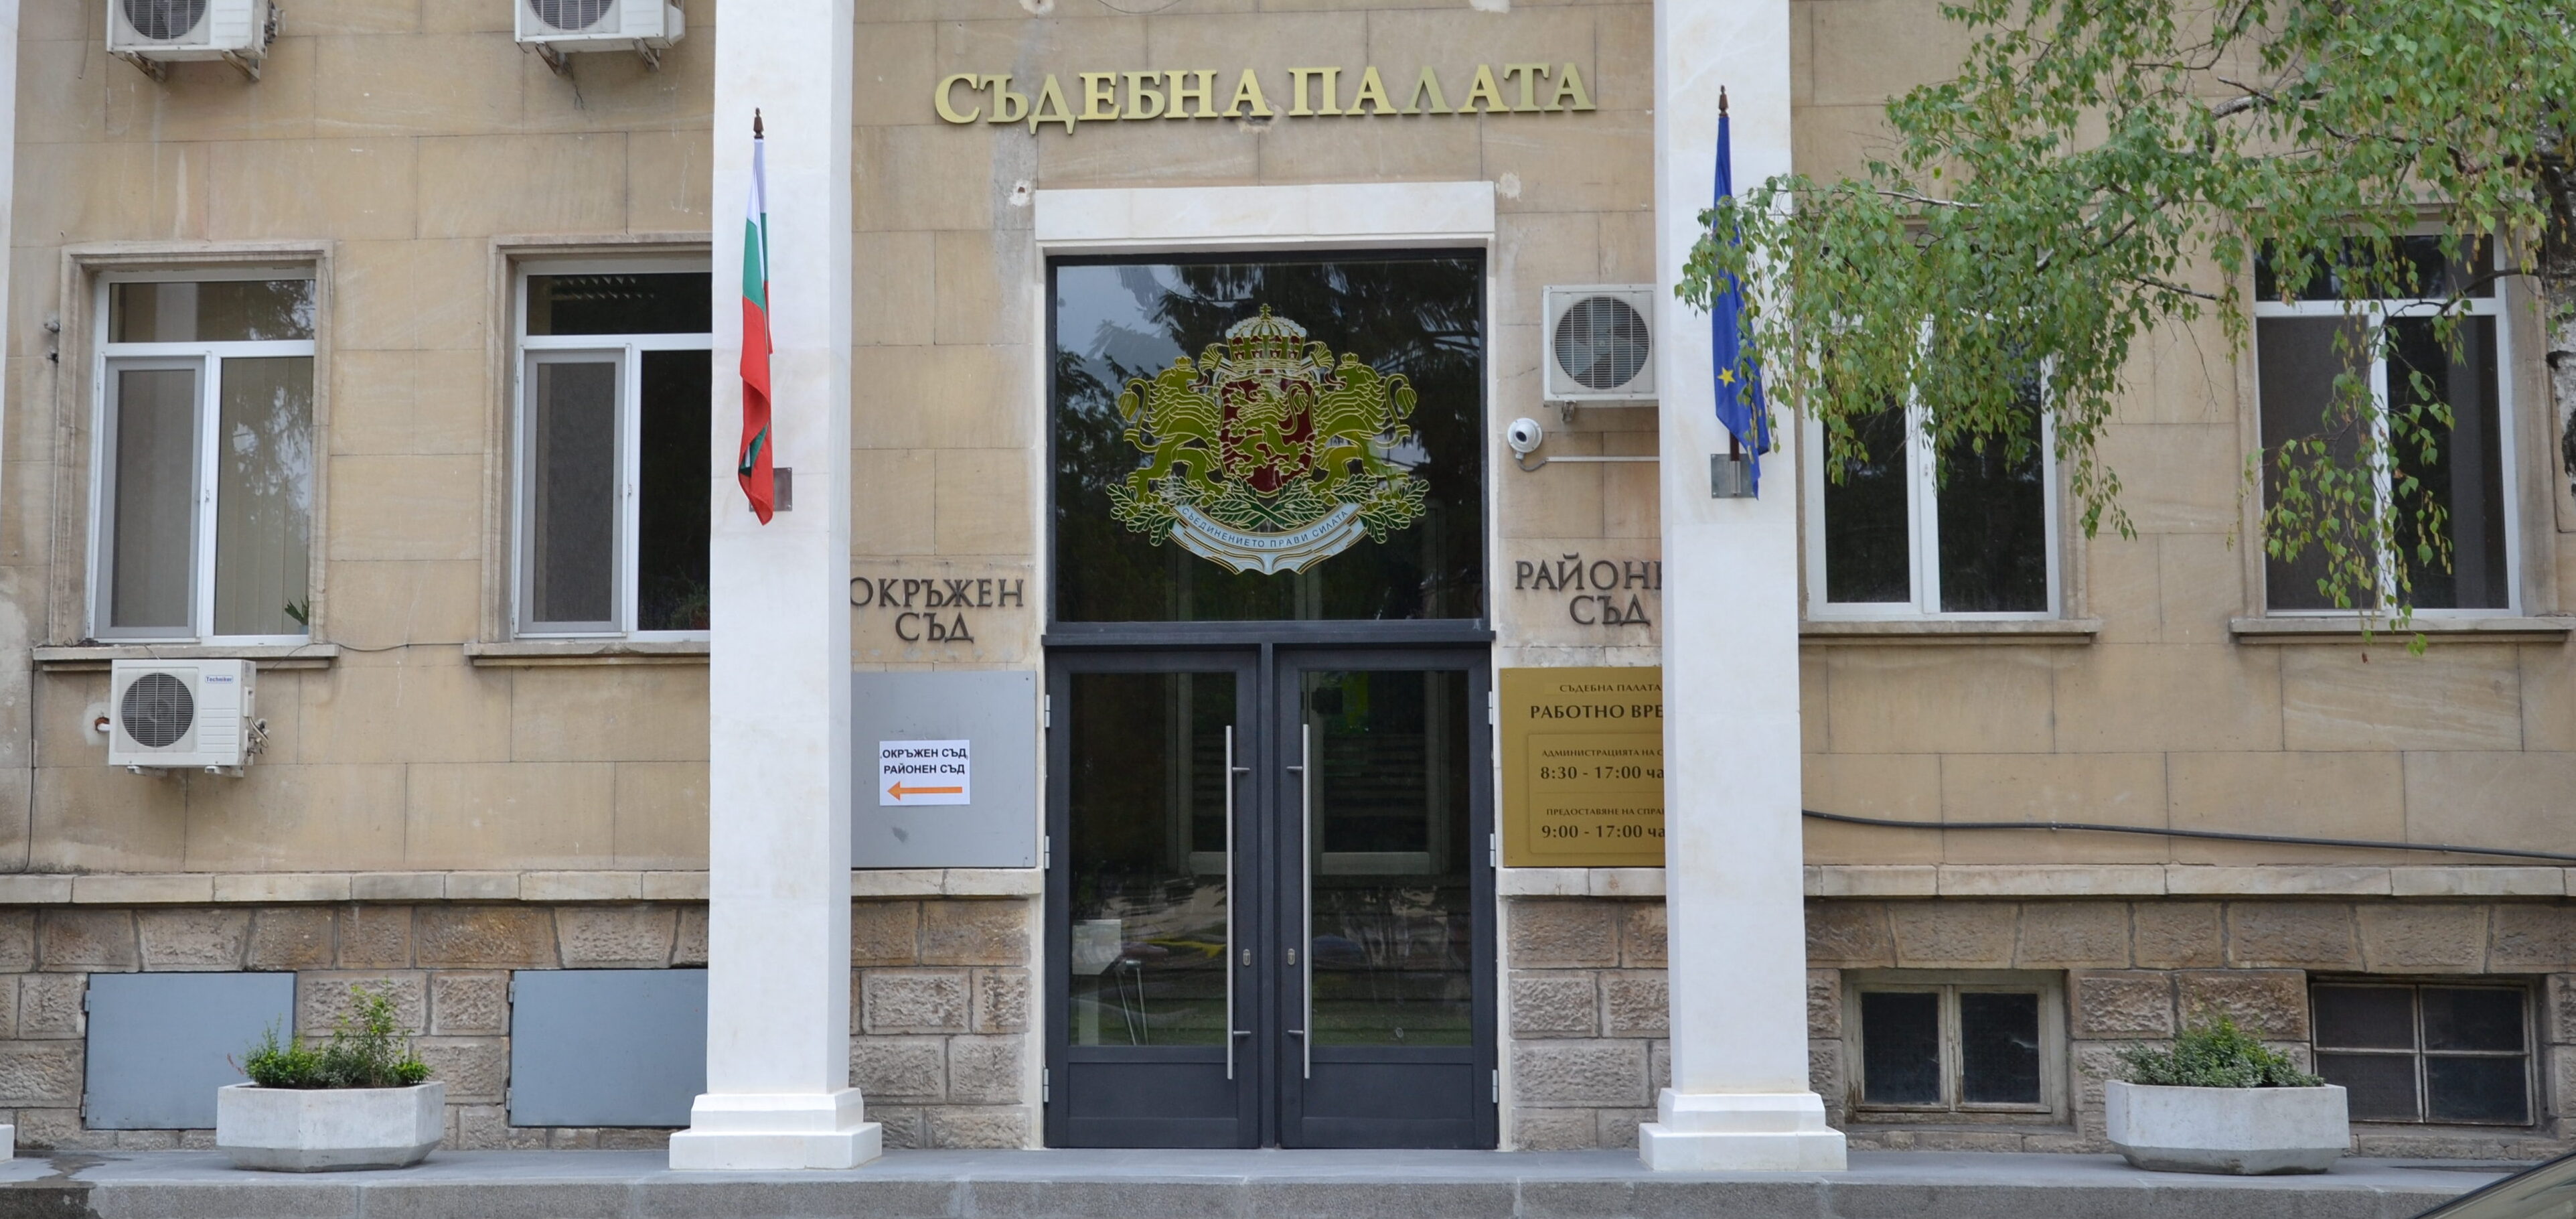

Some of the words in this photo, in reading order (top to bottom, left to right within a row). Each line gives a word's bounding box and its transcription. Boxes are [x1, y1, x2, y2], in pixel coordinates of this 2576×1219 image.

[934, 68, 1274, 135] СЪДЕБНА
[1288, 62, 1596, 115] ПАЛАТА
[1182, 507, 1265, 547] СЪЕДИНЕНИЕТО
[1270, 534, 1308, 548] ПРАВИ
[1312, 510, 1349, 537] СИЛАТА
[850, 577, 1024, 607] ОКРЪЖЕН
[1570, 594, 1651, 626] СЪД
[895, 612, 974, 644] СЪД
[1560, 684, 1613, 693] СЪДЕБНА
[1530, 705, 1624, 719] РАБОТНО
[1632, 705, 1663, 718] ВРЕ
[883, 749, 938, 758] ОКРЪЖЕН
[941, 748, 966, 758] СЪД
[1542, 749, 1639, 758] АДМИНИСТРАЦИЯТА
[884, 763, 937, 774] РАЙОНЕН
[940, 764, 965, 774] СЪД
[1541, 766, 1577, 779] 8:30
[1594, 766, 1641, 779] 17:00
[1546, 808, 1618, 816] ПРЕДОСТАВЯНЕ
[1541, 825, 1578, 838] 9:00
[1596, 824, 1643, 838] 17:00
